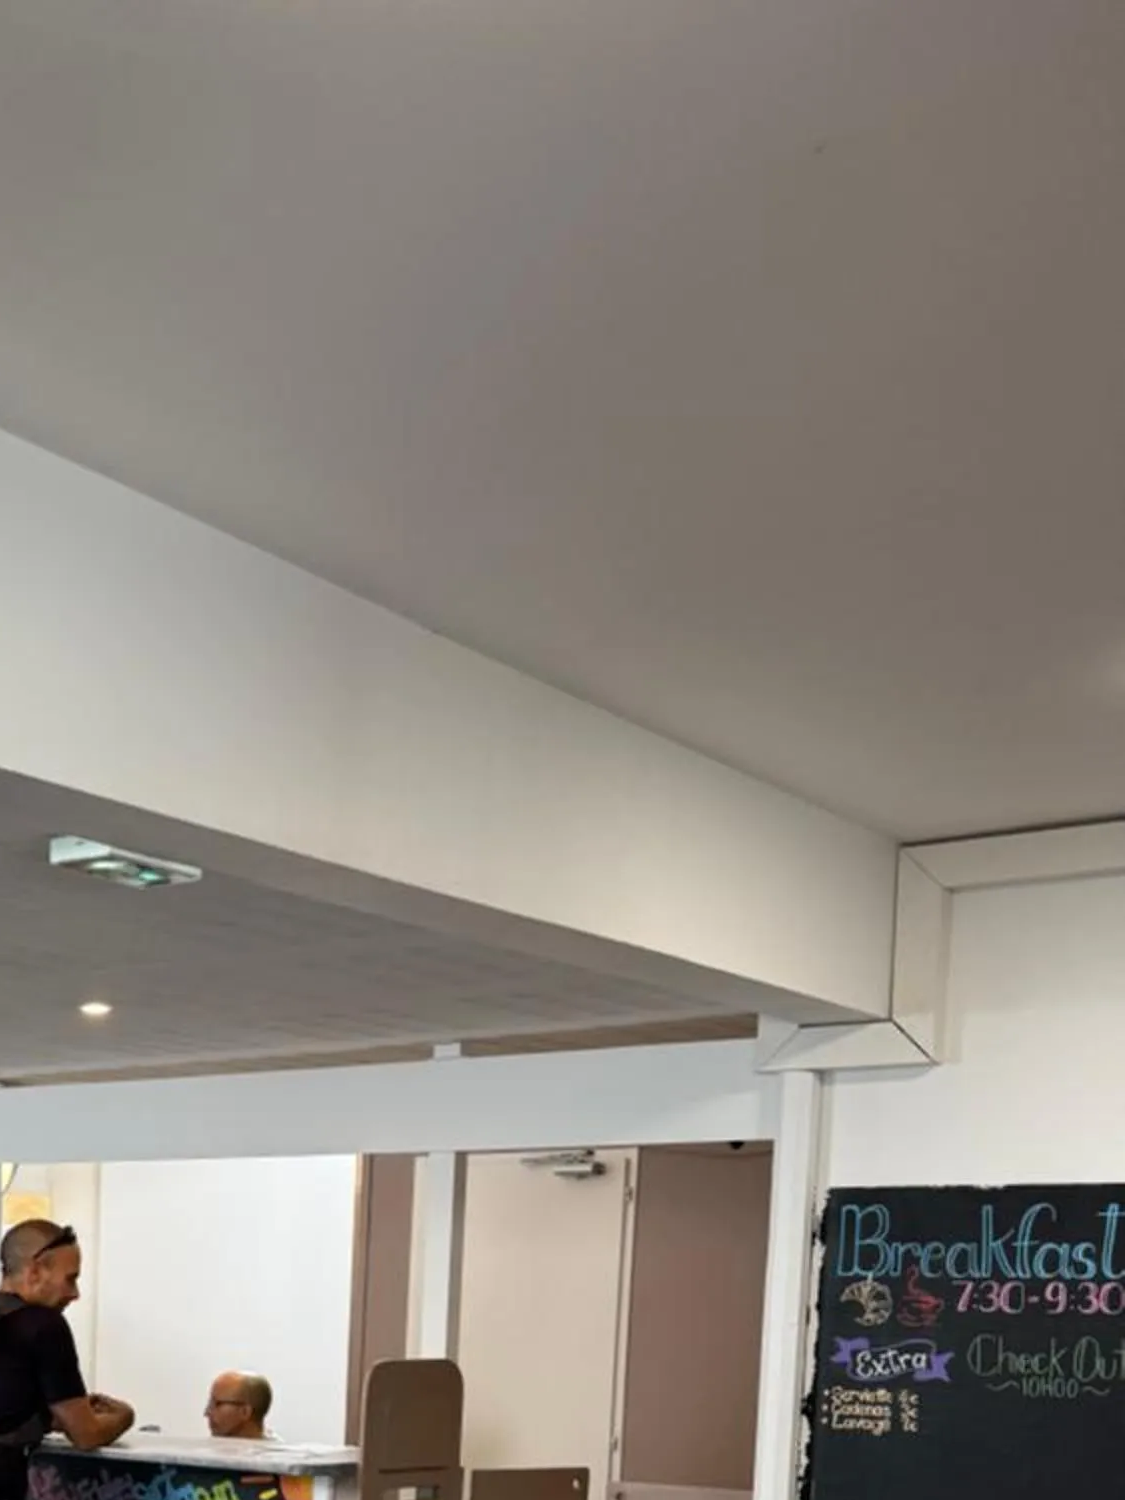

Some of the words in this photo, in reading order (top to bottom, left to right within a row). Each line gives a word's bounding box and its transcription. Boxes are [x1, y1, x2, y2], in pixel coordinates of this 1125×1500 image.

[837, 1202, 1125, 1279] Breakfast
[855, 1349, 928, 1379] Extra
[967, 1333, 1066, 1377] Check
